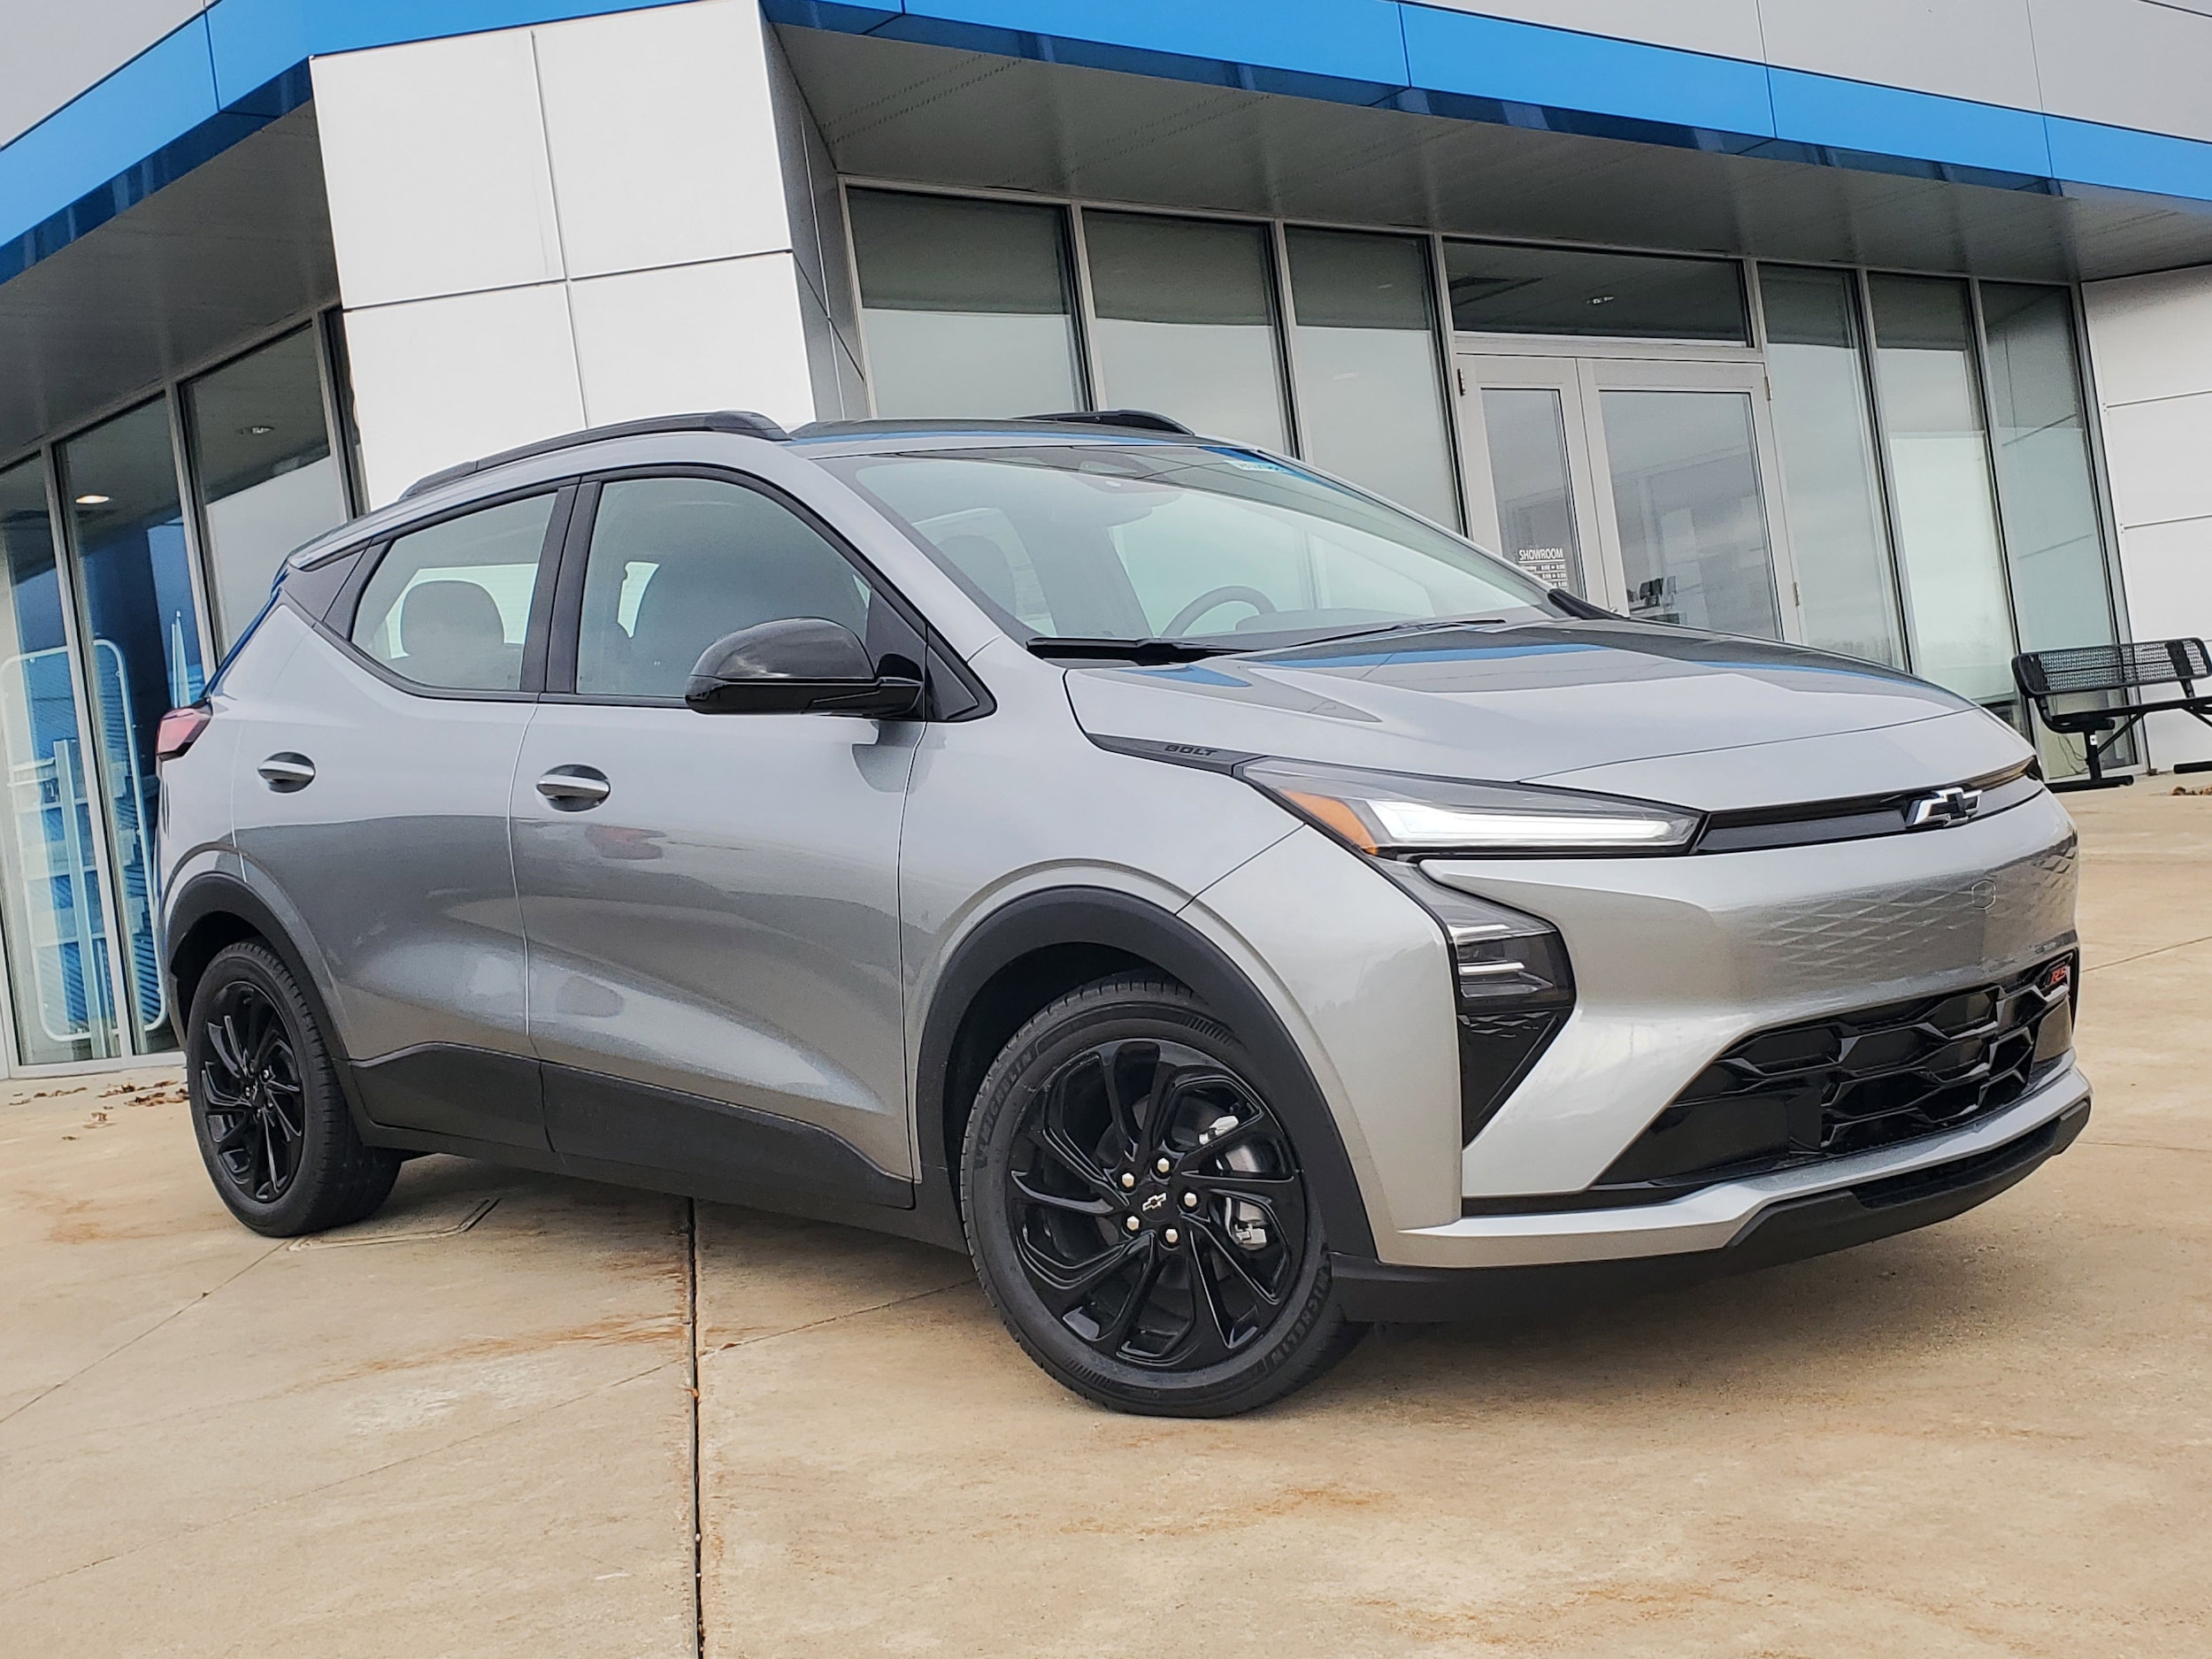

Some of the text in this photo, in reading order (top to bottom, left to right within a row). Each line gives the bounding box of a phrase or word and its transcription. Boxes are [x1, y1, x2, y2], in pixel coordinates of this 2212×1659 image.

[1518, 548, 1564, 561] SHOWROOM
[1164, 744, 1217, 757] BOLT
[2050, 965, 2066, 986] RS
[978, 1048, 1033, 1145] MICHELIN
[1270, 1267, 1330, 1365] MICHELIN
